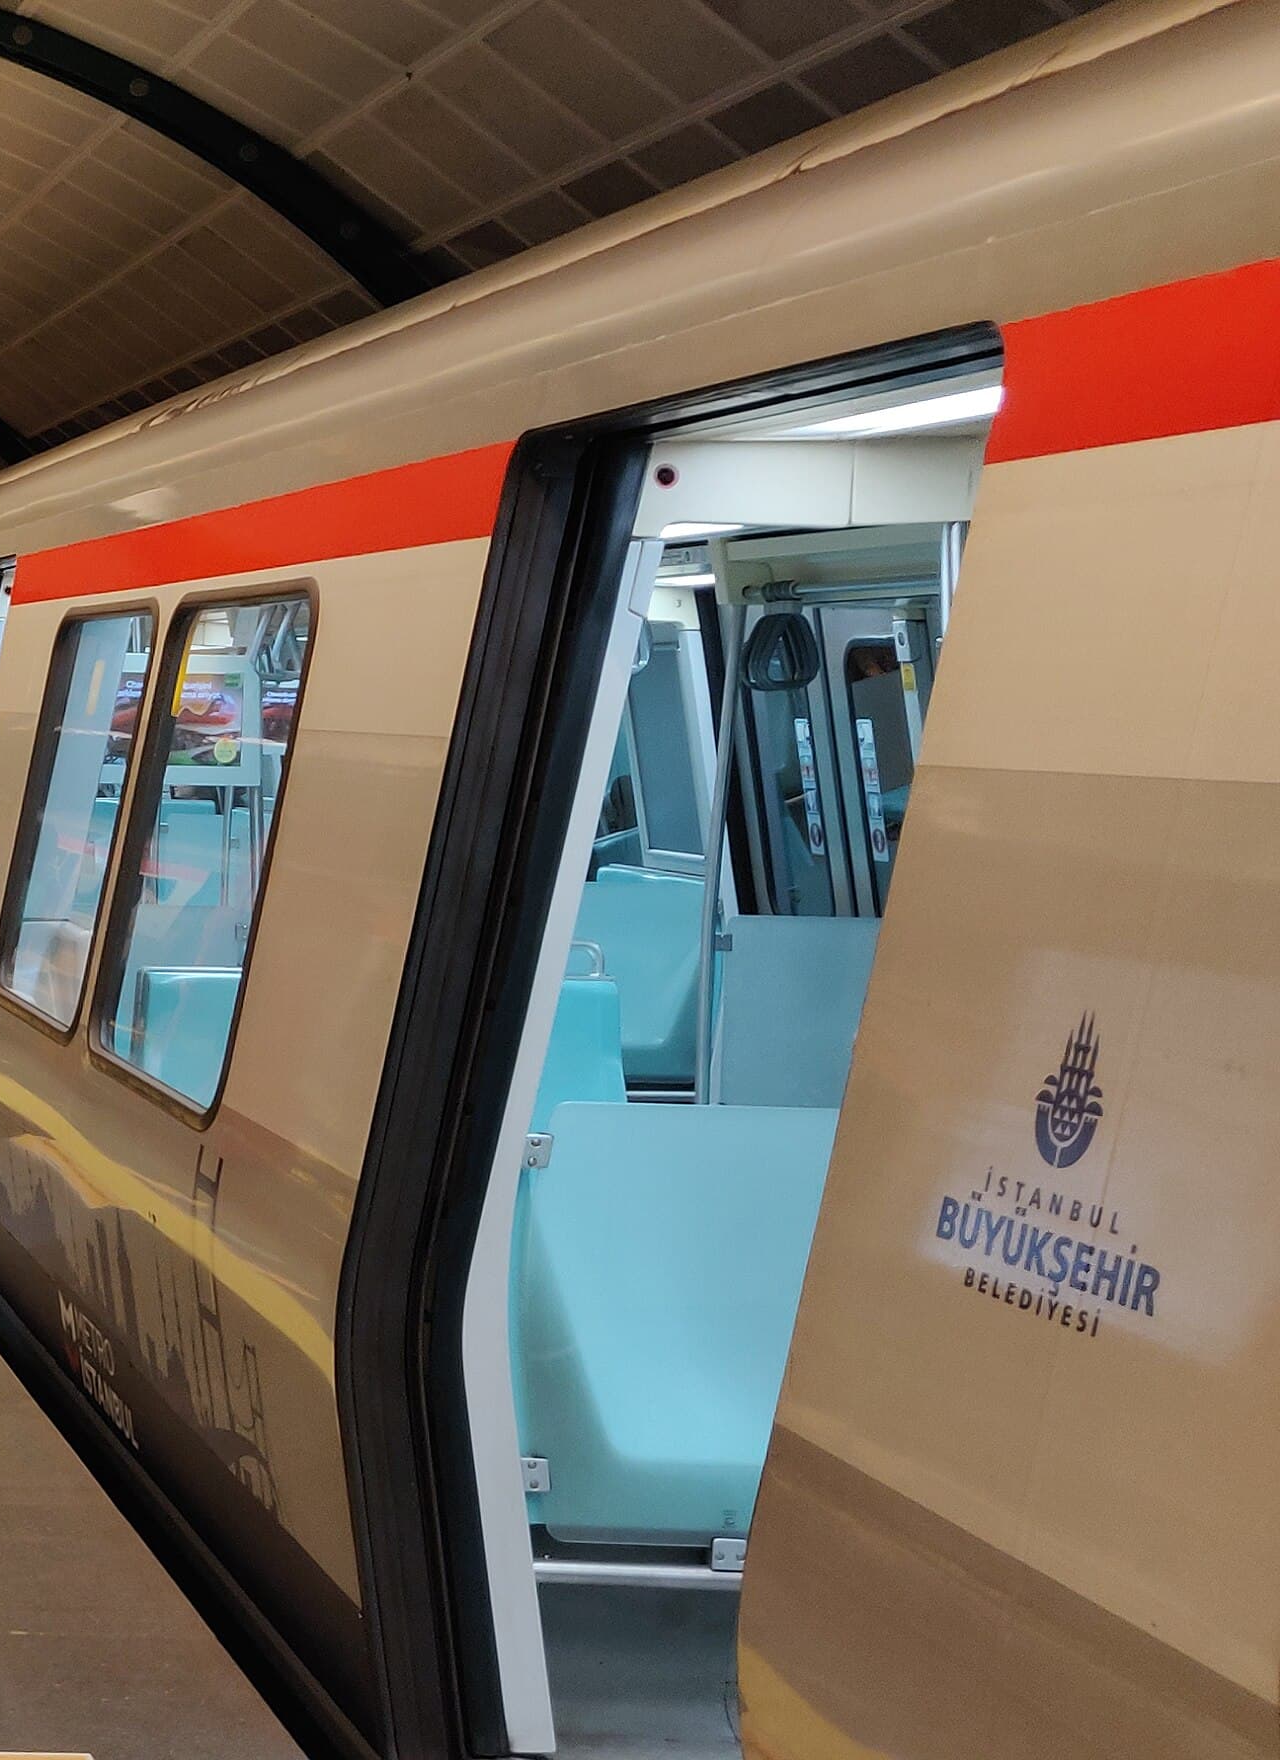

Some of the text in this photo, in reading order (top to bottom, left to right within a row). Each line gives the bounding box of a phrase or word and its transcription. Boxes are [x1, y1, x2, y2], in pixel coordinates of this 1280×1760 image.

[985, 1166, 1119, 1235] İSTANBUL
[935, 1190, 1161, 1317] BÜYÜKŞEHİR
[963, 1267, 1101, 1338] BELEDİYESİ
[74, 1305, 115, 1377] METRO
